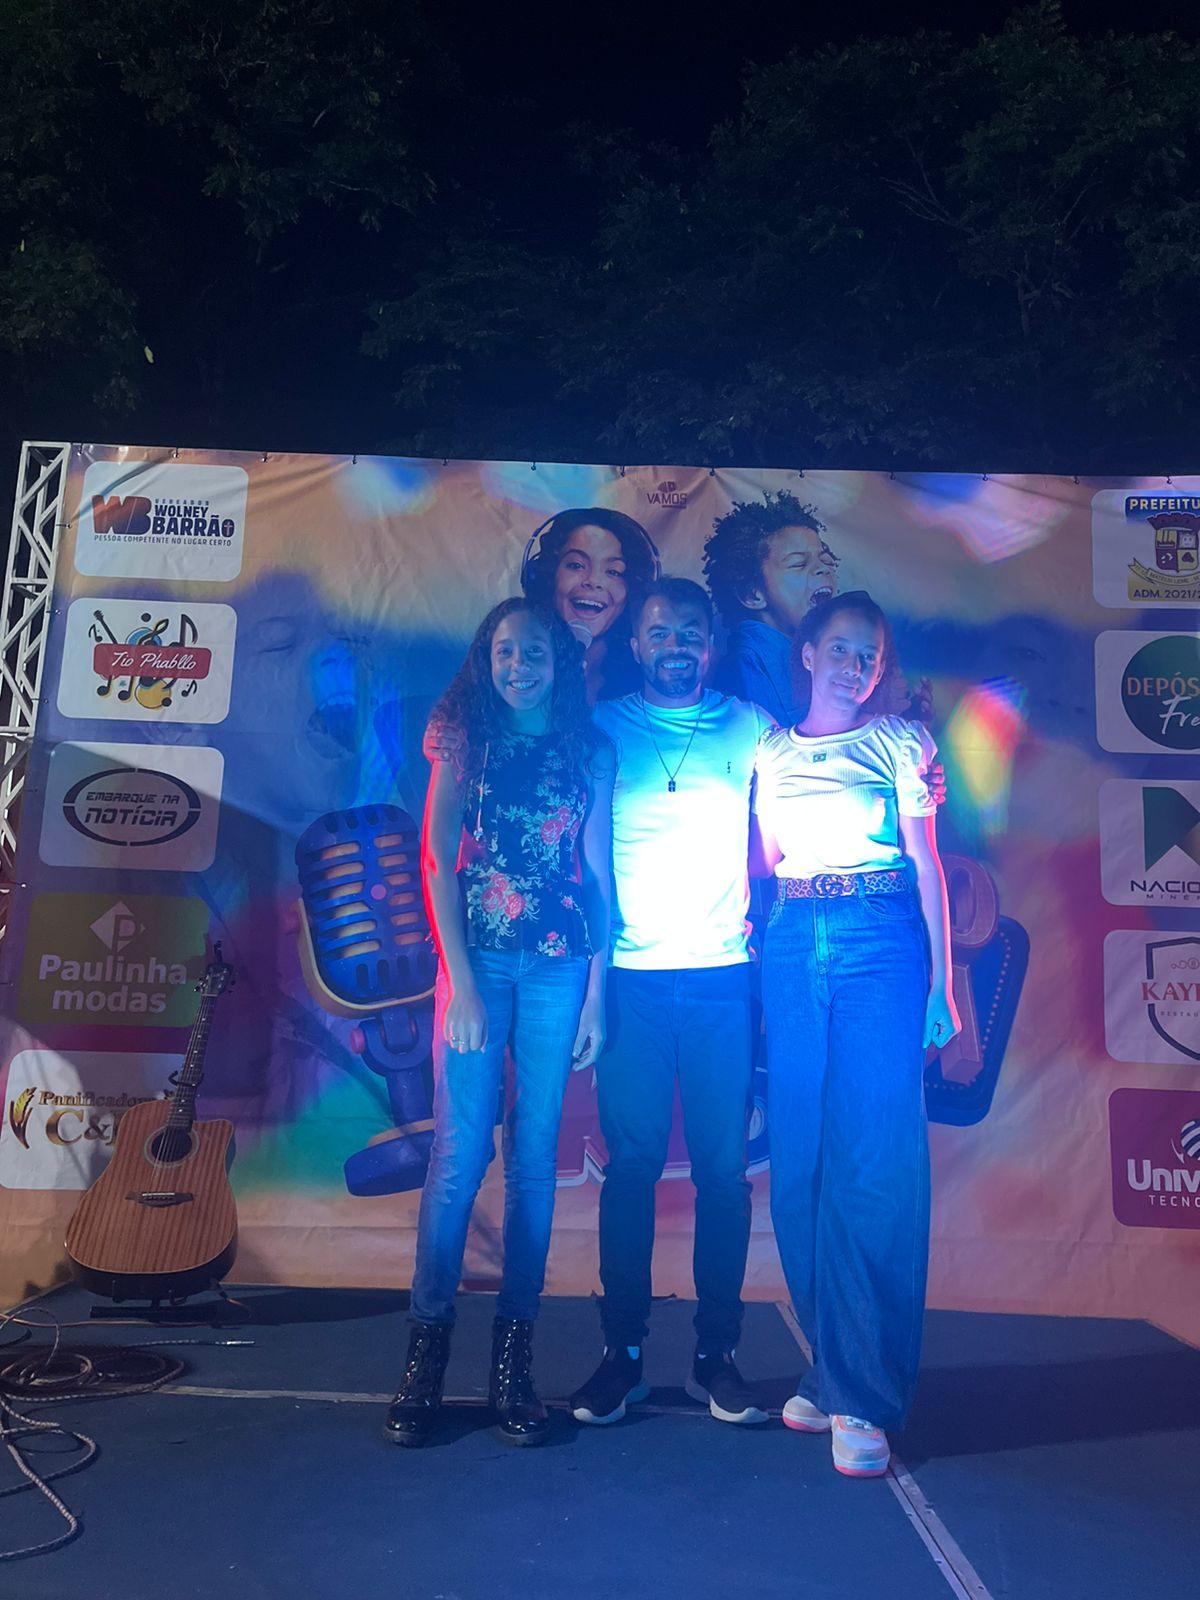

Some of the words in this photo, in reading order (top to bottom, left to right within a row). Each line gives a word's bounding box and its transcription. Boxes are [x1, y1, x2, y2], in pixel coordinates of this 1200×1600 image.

[647, 493, 687, 504] VAMOS
[1129, 499, 1200, 510] PREFEITU
[92, 495, 151, 535] WB
[154, 505, 208, 518] WOLNEY
[152, 515, 235, 538] BARRÃO
[94, 534, 122, 542] PESSOA
[123, 536, 169, 544] COMPETENTE
[171, 537, 182, 545] NO
[183, 538, 207, 546] LUGAR
[209, 539, 232, 547] CERTO
[111, 651, 134, 667] Tio
[139, 652, 197, 670] Phabllo
[1127, 671, 1200, 696] DEPÓS
[86, 791, 157, 804] EMBARQUE
[162, 794, 181, 805] NA
[85, 805, 178, 827] NOTÍCIA
[38, 954, 187, 985] Paulinha
[51, 985, 167, 1014] modas
[1141, 982, 1200, 1001] KAY
